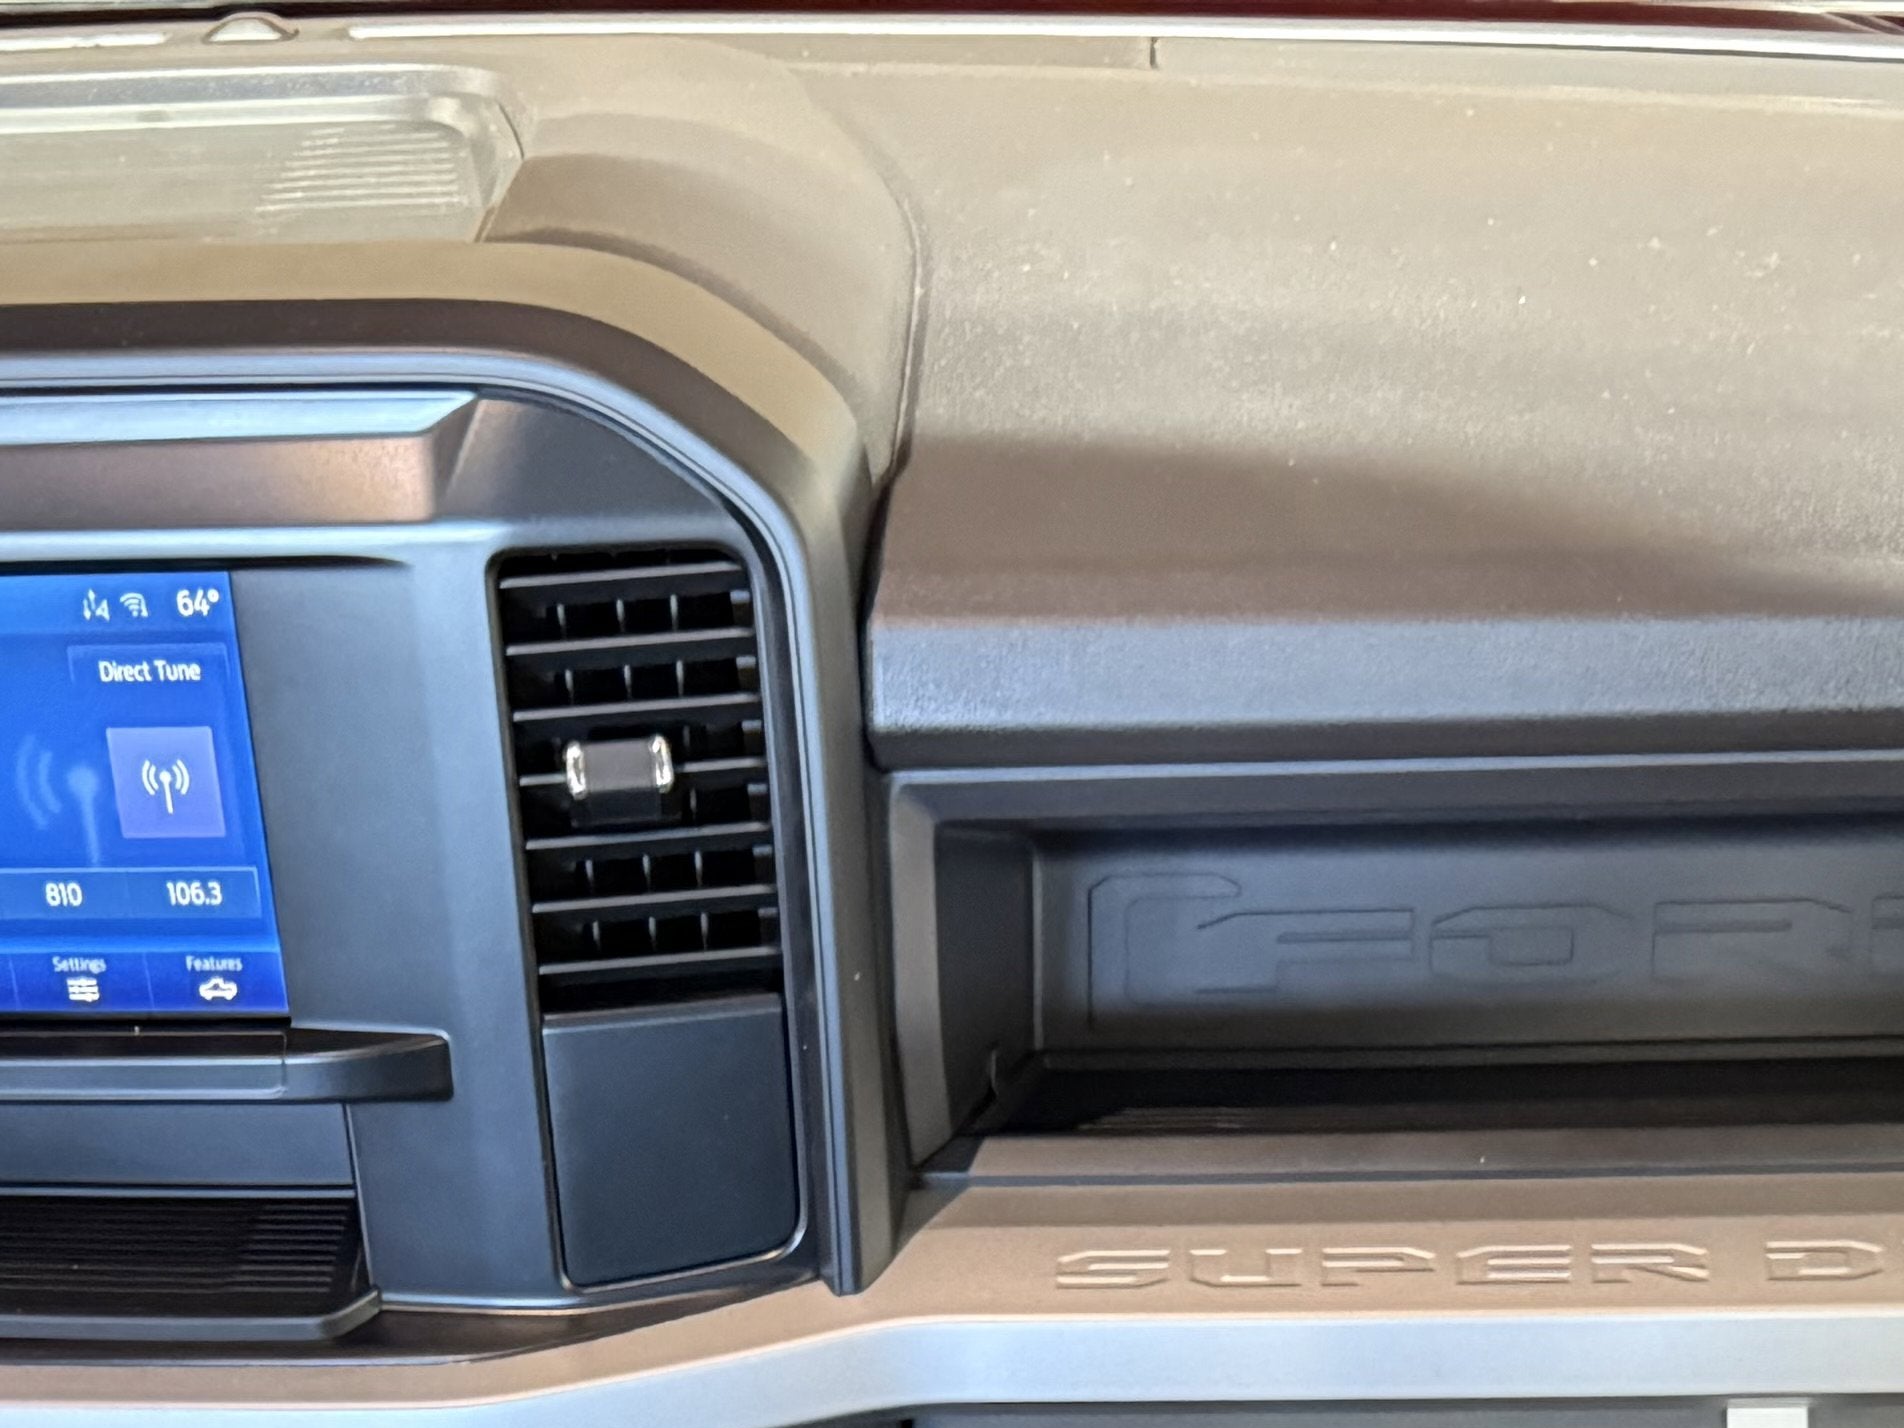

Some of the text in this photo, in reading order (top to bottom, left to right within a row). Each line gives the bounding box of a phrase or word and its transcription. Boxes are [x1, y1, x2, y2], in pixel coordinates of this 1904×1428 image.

[176, 587, 220, 617] 64°
[98, 658, 201, 683] Direct Tune
[45, 881, 83, 907] 810
[166, 881, 223, 906] 106.3
[51, 954, 107, 974] Settings
[185, 954, 243, 973] Features
[1056, 1243, 1710, 1290] SUPER
